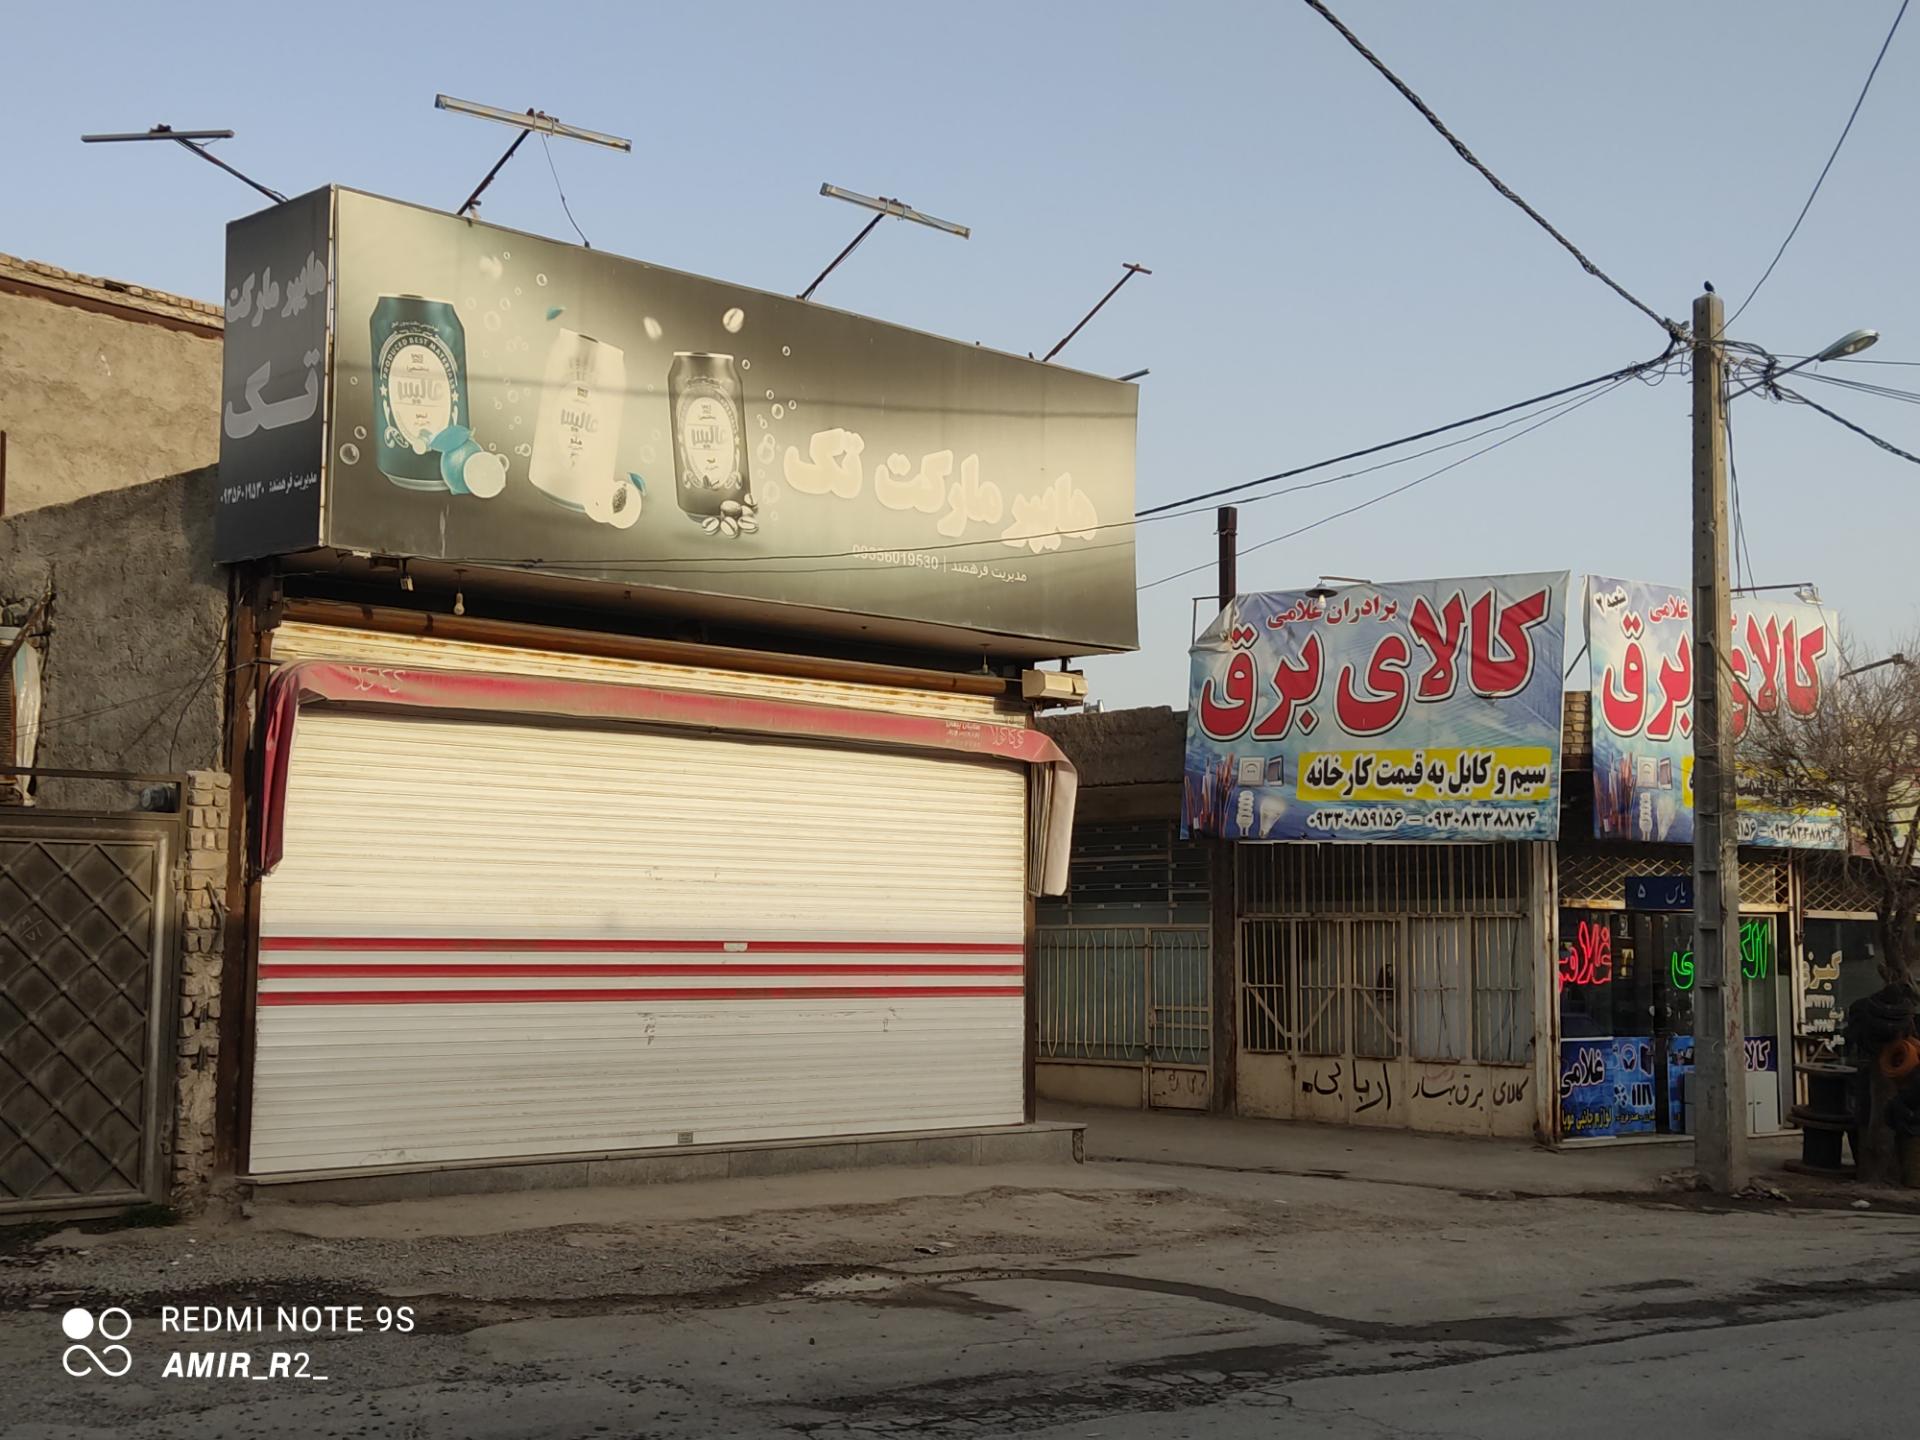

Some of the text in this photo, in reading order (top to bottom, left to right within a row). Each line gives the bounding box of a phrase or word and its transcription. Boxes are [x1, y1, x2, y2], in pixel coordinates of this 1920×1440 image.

[227, 251, 326, 327] هایپر مارکت
[408, 336, 428, 346] BEST
[224, 348, 320, 439] تک
[784, 428, 1098, 554] هایپر مارکت تک
[951, 563, 989, 578] فرهمند
[991, 569, 1027, 583] مدیریت
[1327, 596, 1398, 624] برادران
[1596, 589, 1628, 615] شعبه ۲
[1650, 596, 1690, 622] غلامی
[1199, 586, 1550, 741] کالای برق
[1602, 615, 1694, 741] برق
[1306, 753, 1547, 796] سیم و کابل به قیمت کارخانه
[1308, 810, 1537, 828] ۰۹۳۰۸۳۳۸۸۷۴ ۰۹۳۳۰۸۵۹۱۵۶
[1637, 882, 1687, 905] یاس ۵
[1455, 1074, 1485, 1112] برق
[1493, 1075, 1529, 1107] کالای
